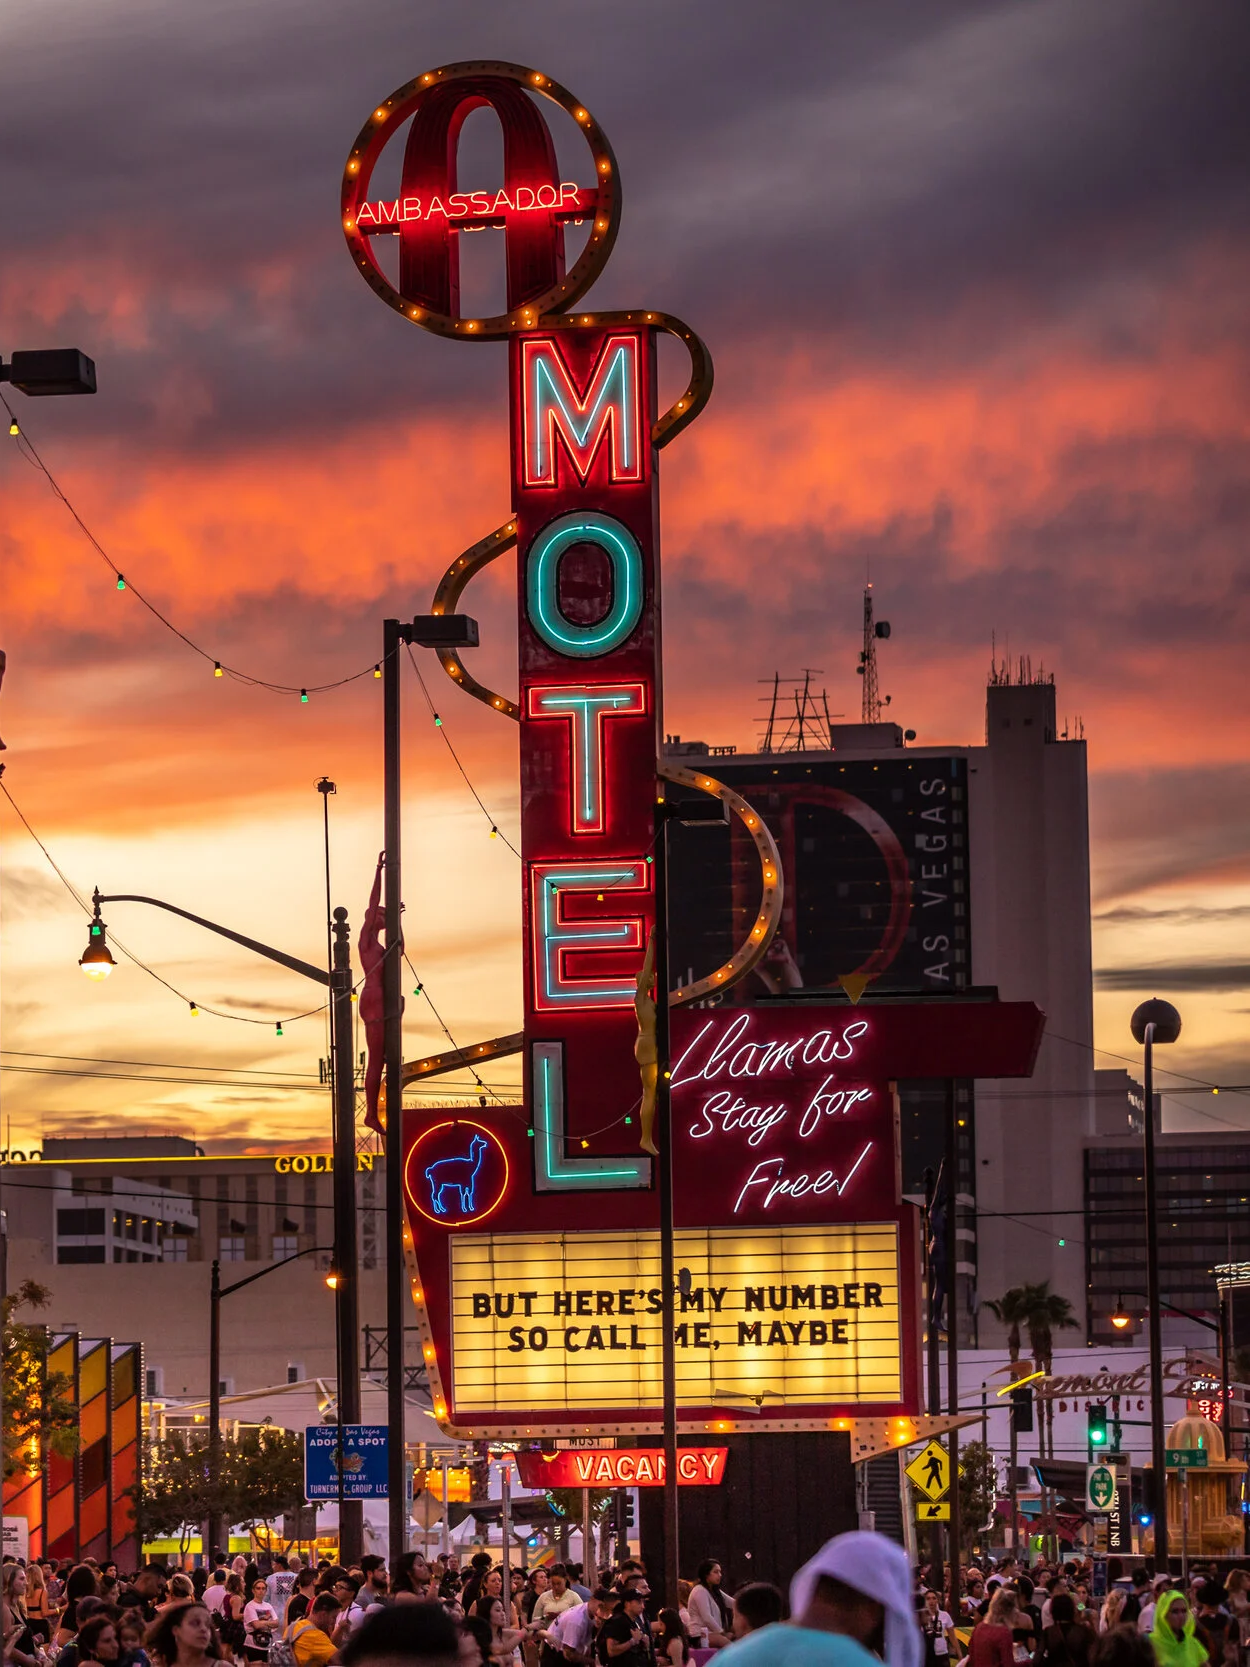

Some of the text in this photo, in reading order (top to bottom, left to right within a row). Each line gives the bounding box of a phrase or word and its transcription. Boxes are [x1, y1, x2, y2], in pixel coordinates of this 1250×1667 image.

[355, 181, 581, 225] AMBASSADOR
[521, 335, 652, 1190] MOTEL
[919, 778, 950, 981] AS VEGAS
[670, 1014, 869, 1089] Llamas
[689, 1074, 873, 1146] Stay for
[275, 1154, 374, 1174] GOLN
[472, 1282, 884, 1319] BUT HERE'S MY NUMBER
[508, 1326, 548, 1352] SO
[564, 1324, 646, 1352] CALL
[737, 1318, 849, 1347] MAYBE
[309, 1437, 386, 1447] ADOP A SPOT
[351, 1484, 373, 1493] GROUP
[375, 1483, 388, 1493] LLC
[1110, 1532, 1121, 1547] NB
